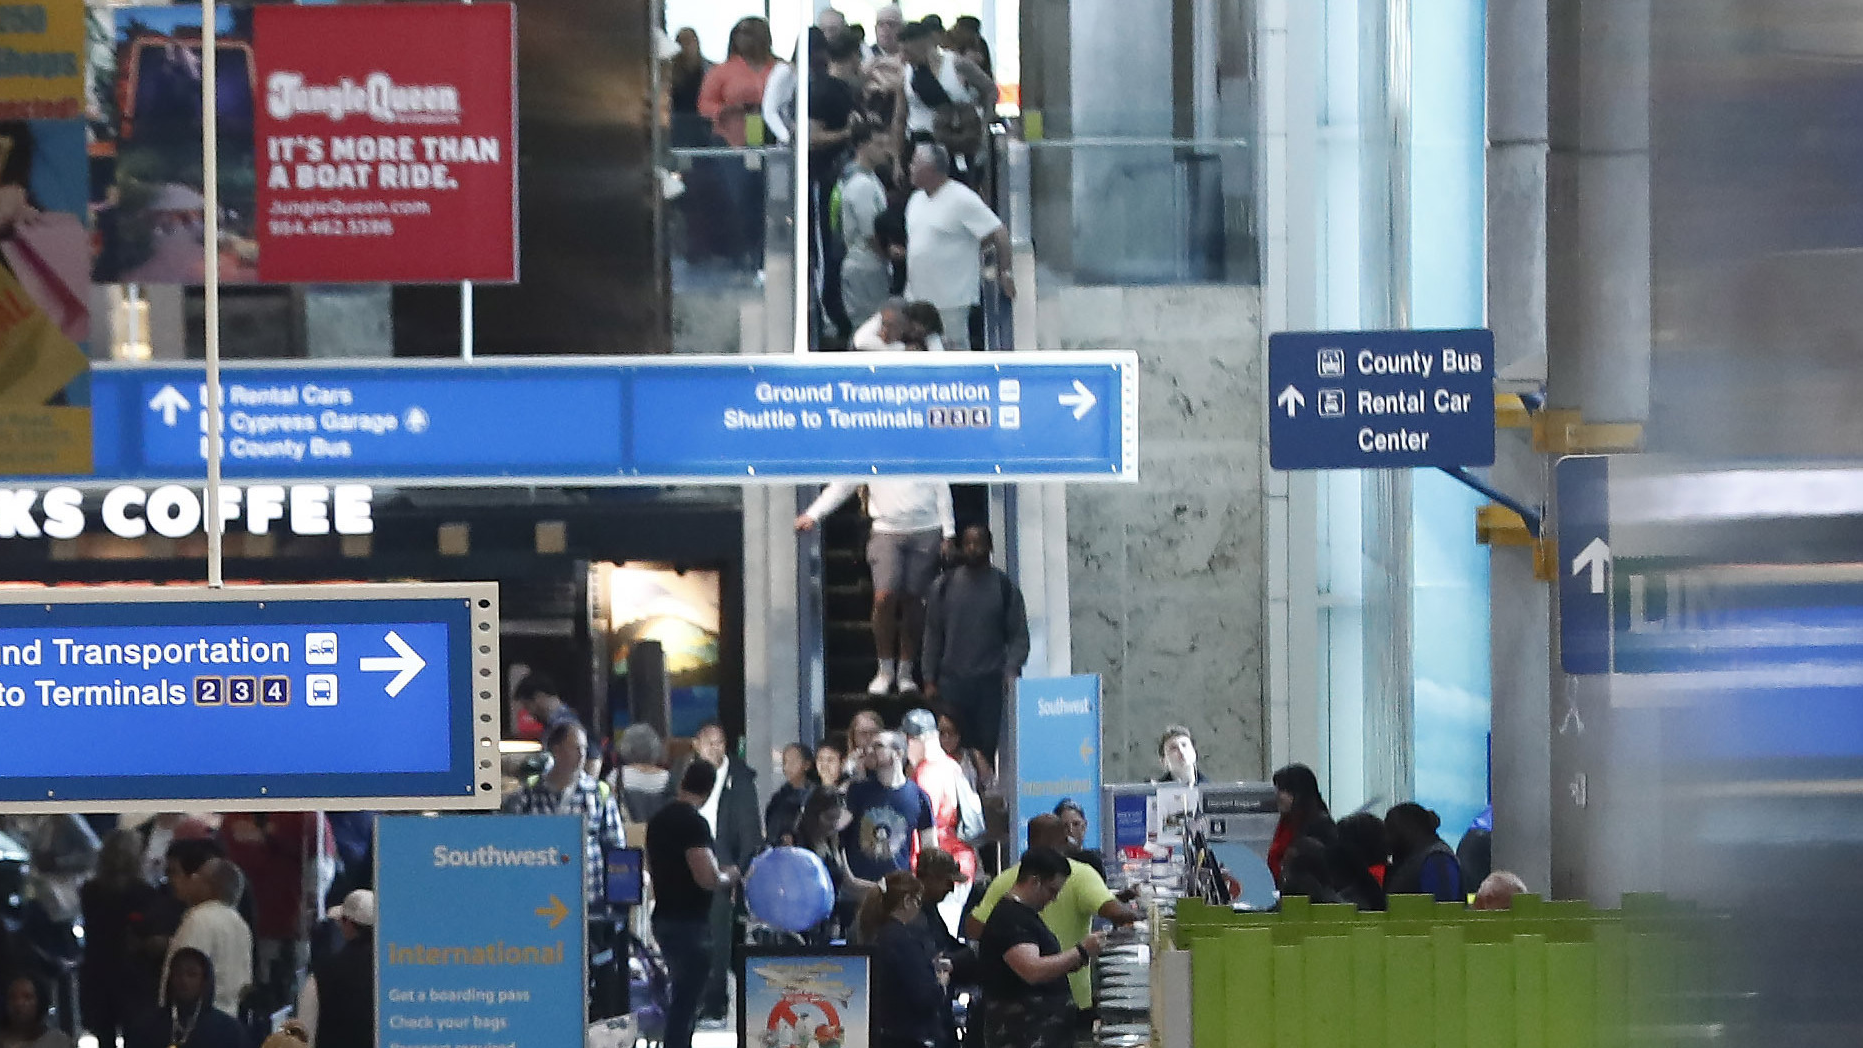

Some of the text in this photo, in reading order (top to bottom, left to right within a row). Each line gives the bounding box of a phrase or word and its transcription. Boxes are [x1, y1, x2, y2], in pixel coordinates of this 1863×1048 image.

[330, 136, 415, 162] MORE
[421, 136, 500, 163] THAN
[268, 164, 459, 190] A BOAT RIDE.
[1357, 348, 1482, 378] County Bus
[230, 384, 353, 405] Rental Cars
[756, 382, 990, 406] Ground Transportation
[1358, 389, 1472, 414] Rental Car
[230, 410, 398, 435] Cypress Garage
[724, 408, 797, 429] Shuttle
[801, 409, 822, 429] to
[827, 408, 923, 429] Terminals
[230, 437, 352, 461] County Bus
[1358, 428, 1430, 452] Center
[101, 485, 374, 538] COFFEE
[52, 635, 290, 672] Transportation
[35, 678, 186, 706] Terminals
[1038, 697, 1090, 717] Southwest
[433, 845, 559, 868] Southwest
